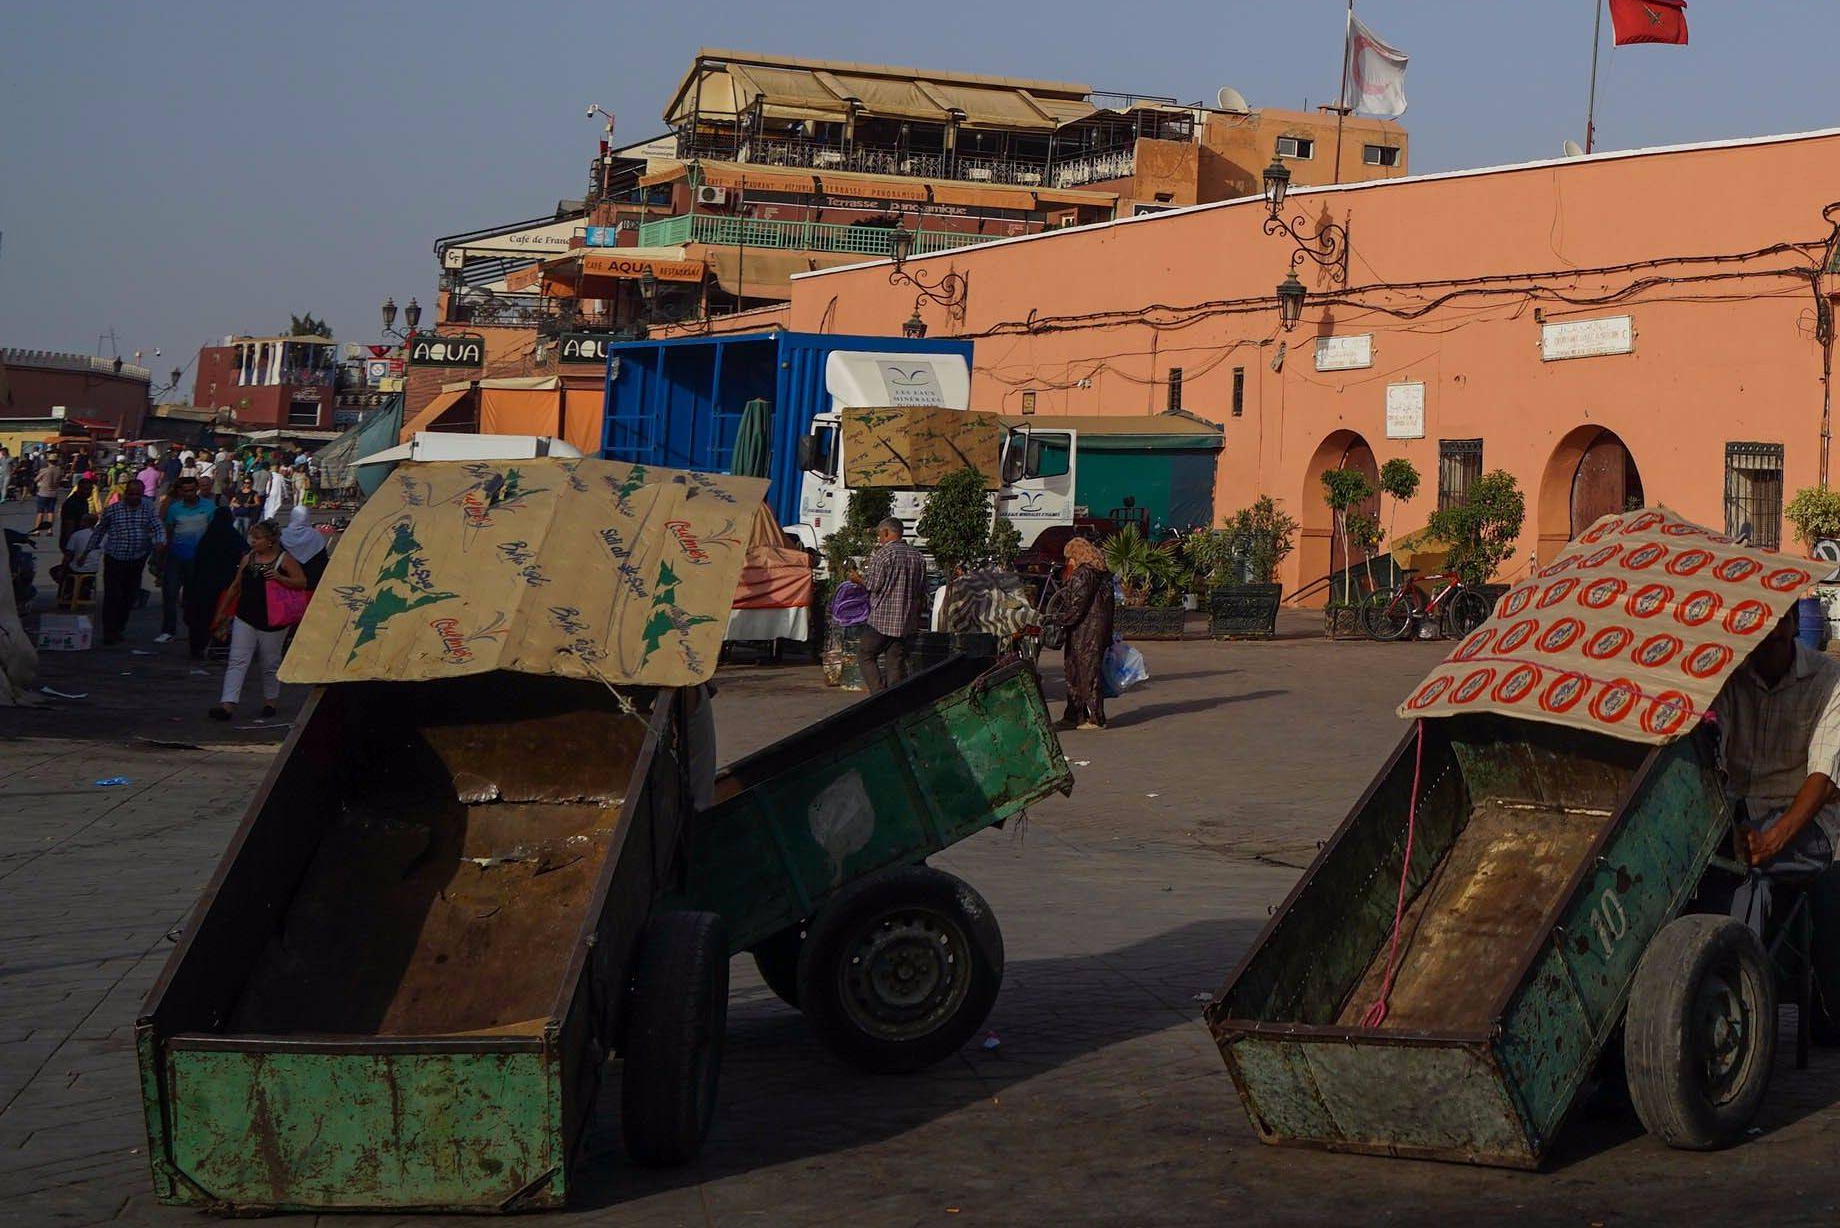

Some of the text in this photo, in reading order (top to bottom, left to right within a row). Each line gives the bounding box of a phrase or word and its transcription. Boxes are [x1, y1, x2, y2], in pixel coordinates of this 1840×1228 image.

[825, 185, 861, 194] TERRASSE
[871, 189, 925, 199] PANORAMIQUE
[826, 197, 879, 208] Terrasse
[509, 234, 530, 246] Café
[532, 234, 542, 244] de
[413, 342, 480, 362] AQUA
[600, 528, 623, 545] Sidi
[611, 547, 632, 558] ali
